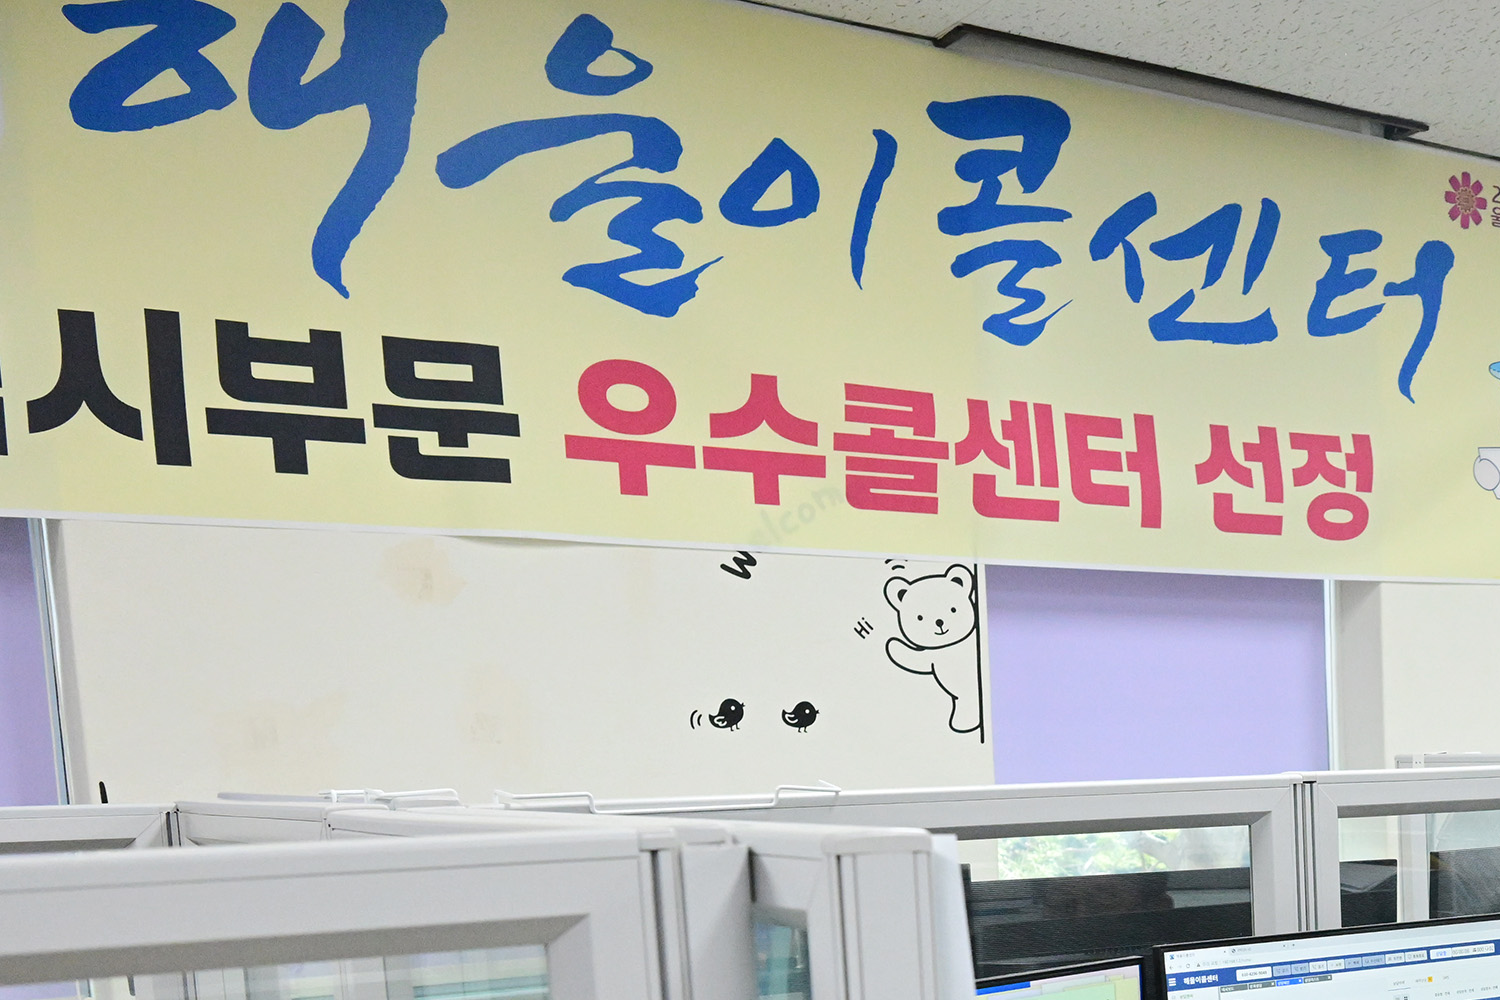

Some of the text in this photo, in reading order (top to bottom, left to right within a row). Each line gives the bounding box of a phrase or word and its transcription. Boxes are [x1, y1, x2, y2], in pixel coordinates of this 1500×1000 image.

[0, 307, 1376, 542] 시부문 우수콜센터 선정
[853, 617, 874, 639] Hi
[1183, 974, 1219, 986] 해울이콜센터
